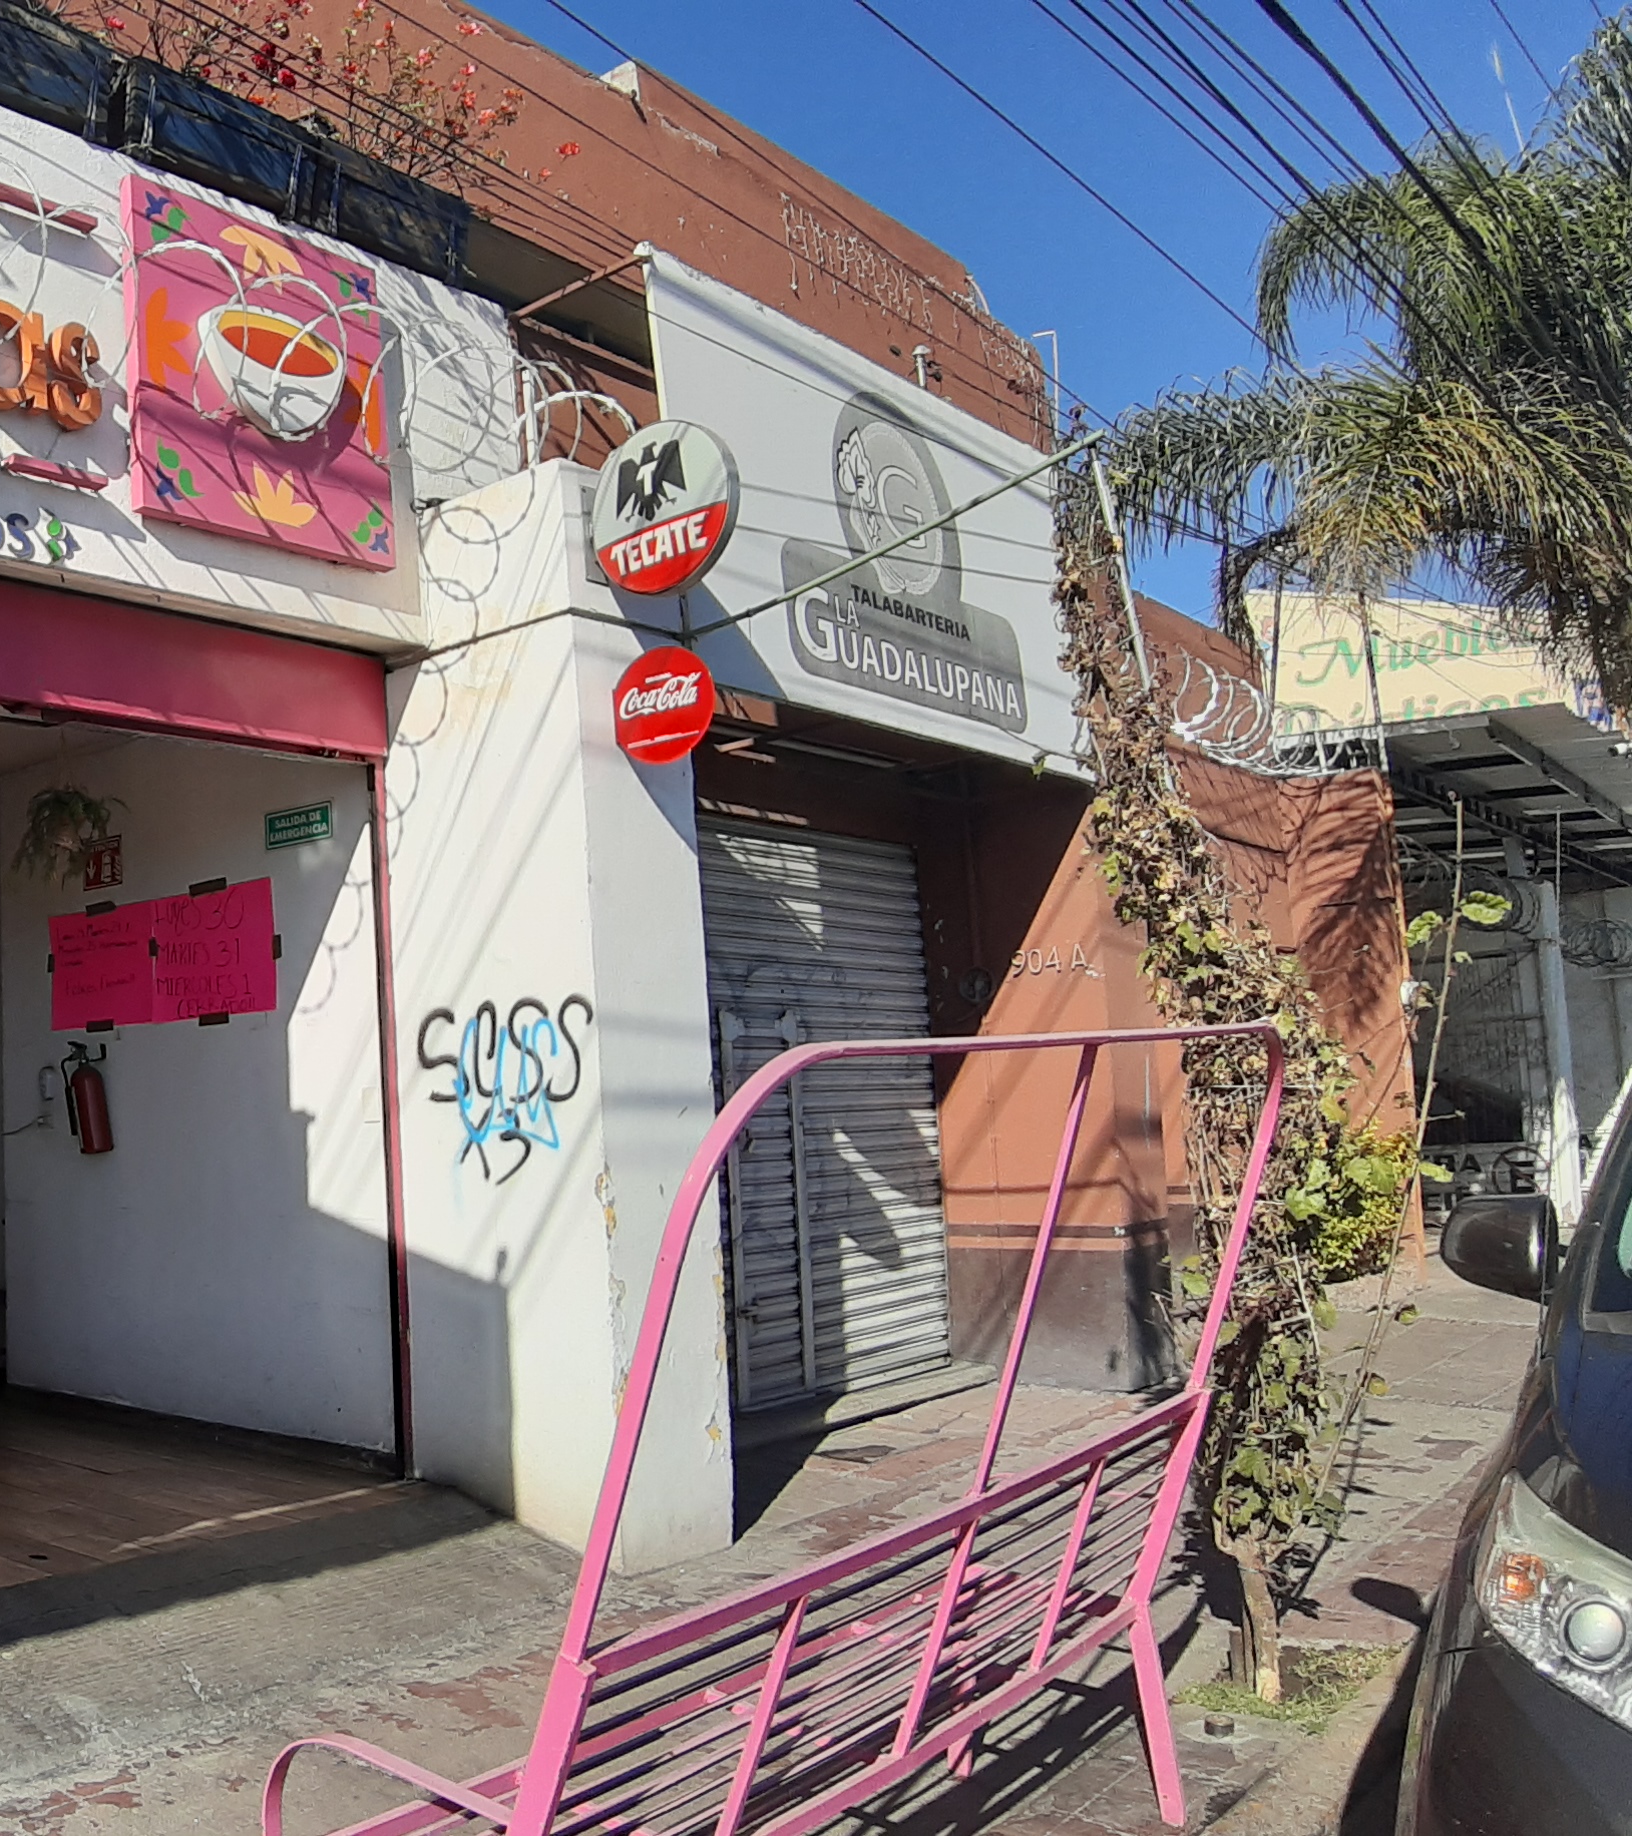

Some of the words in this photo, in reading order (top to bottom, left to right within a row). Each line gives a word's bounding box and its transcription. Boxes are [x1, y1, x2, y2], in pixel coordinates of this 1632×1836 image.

[610, 511, 708, 577] TECATE
[834, 595, 860, 629] LA
[850, 584, 971, 641] TALABARTERIA
[793, 585, 1023, 719] GUADALUPANA
[270, 822, 328, 842] EMERGENCIA
[275, 813, 307, 829] SALIDA
[309, 810, 322, 822] DE
[216, 938, 240, 967] 31
[1012, 946, 1061, 978] 904
[1071, 943, 1089, 971] A
